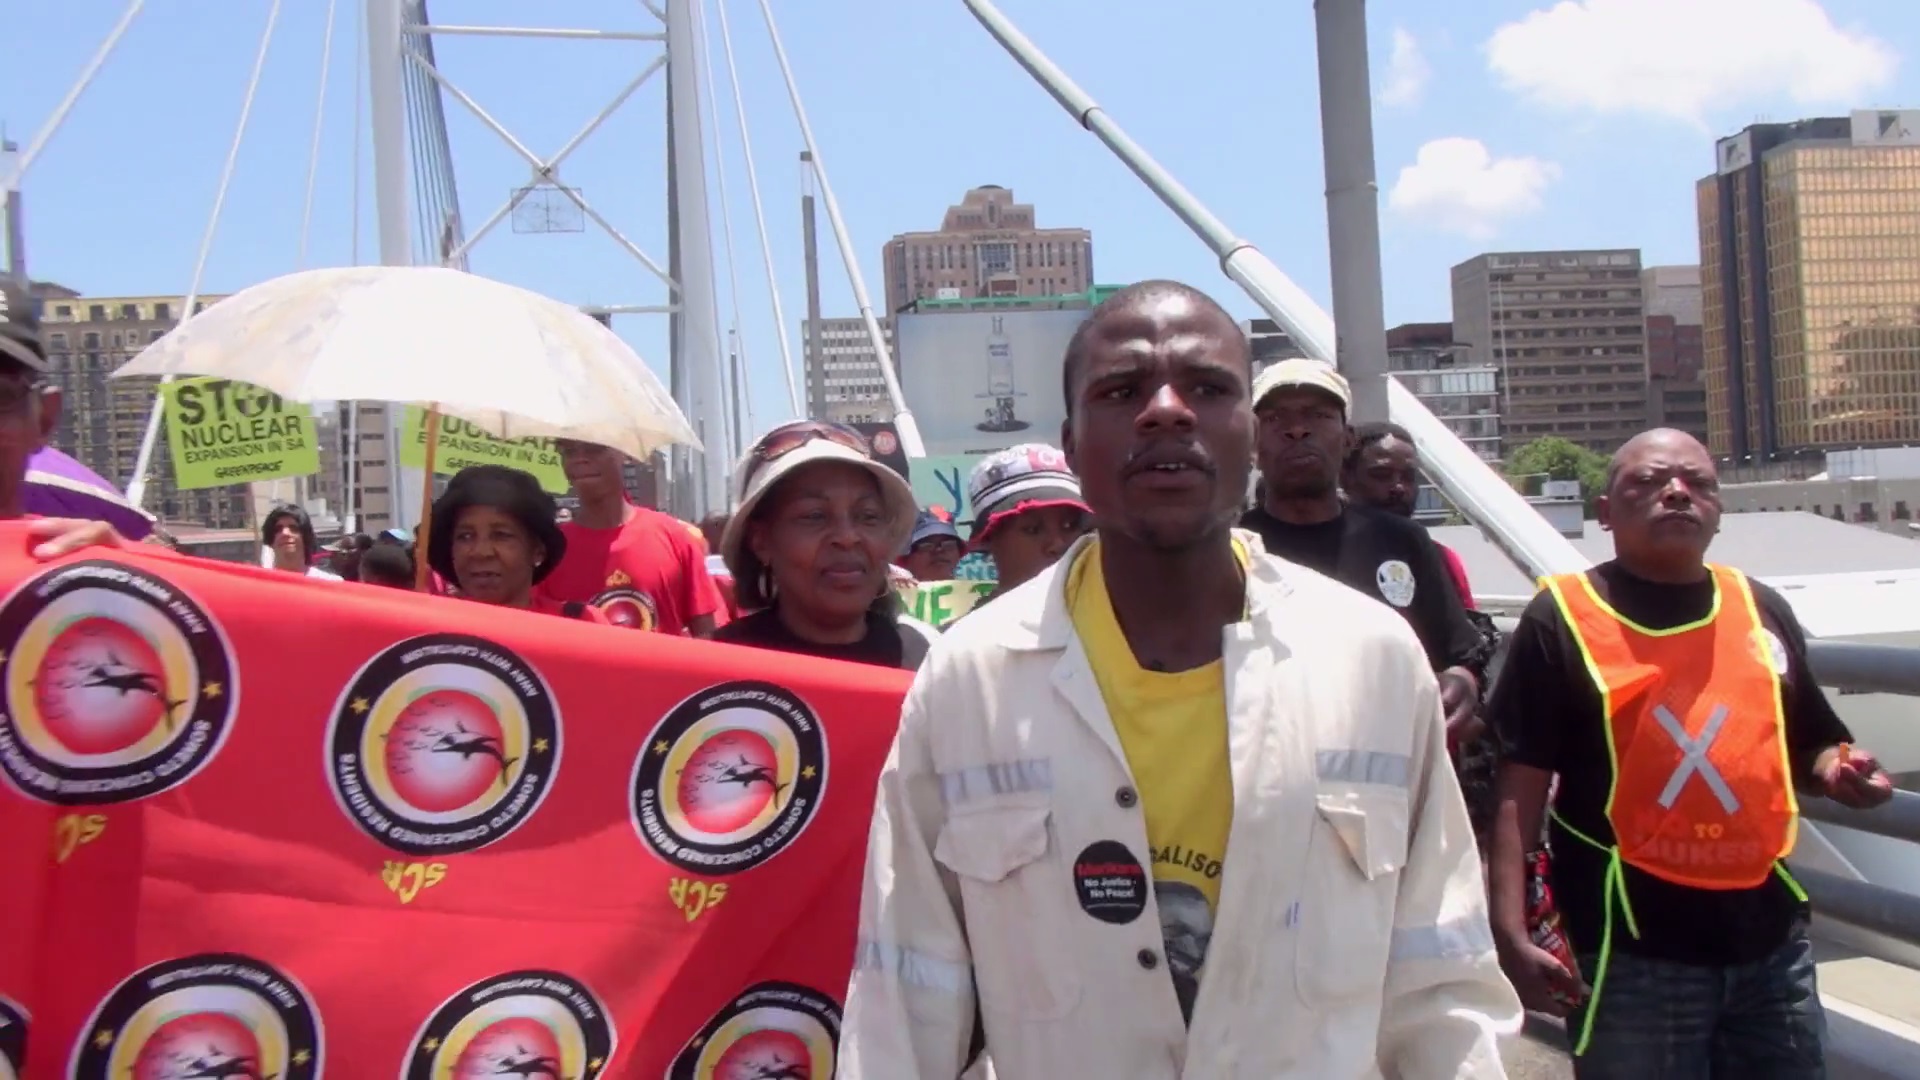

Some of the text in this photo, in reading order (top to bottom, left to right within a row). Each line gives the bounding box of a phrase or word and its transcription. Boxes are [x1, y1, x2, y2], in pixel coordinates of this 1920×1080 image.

[181, 415, 303, 449] NUCLEAR
[417, 431, 511, 459] EPANSION
[538, 452, 560, 467] SA
[184, 438, 306, 464] EXPANSION IN SA
[490, 773, 539, 829] SOWETO
[764, 797, 807, 848] SOWETO
[1693, 823, 1724, 839] TO
[668, 877, 729, 922] SCR
